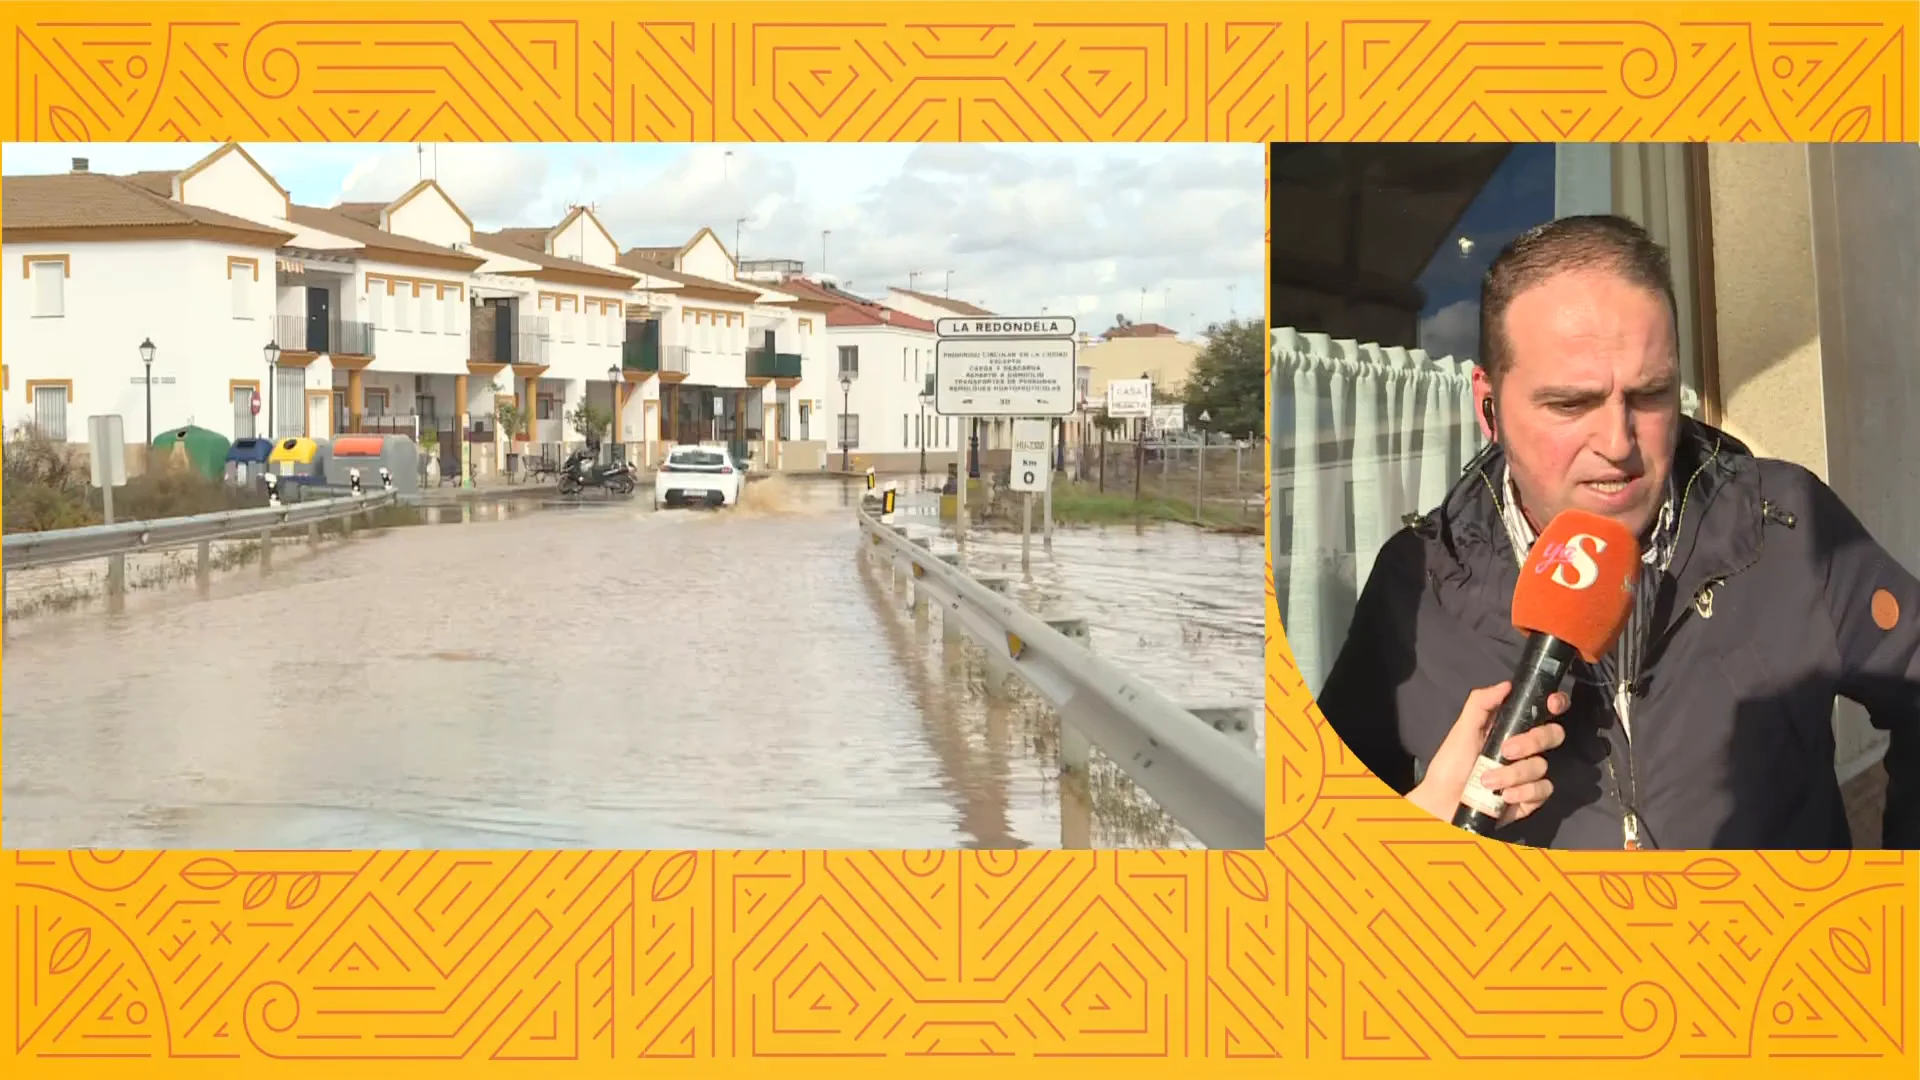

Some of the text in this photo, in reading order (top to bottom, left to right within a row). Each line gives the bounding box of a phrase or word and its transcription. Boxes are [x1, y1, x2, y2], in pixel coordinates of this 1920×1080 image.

[953, 321, 1059, 333] LA REDONDELA
[1023, 459, 1037, 467] Km
[1023, 471, 1035, 485] 0
[1551, 533, 1608, 590] S
